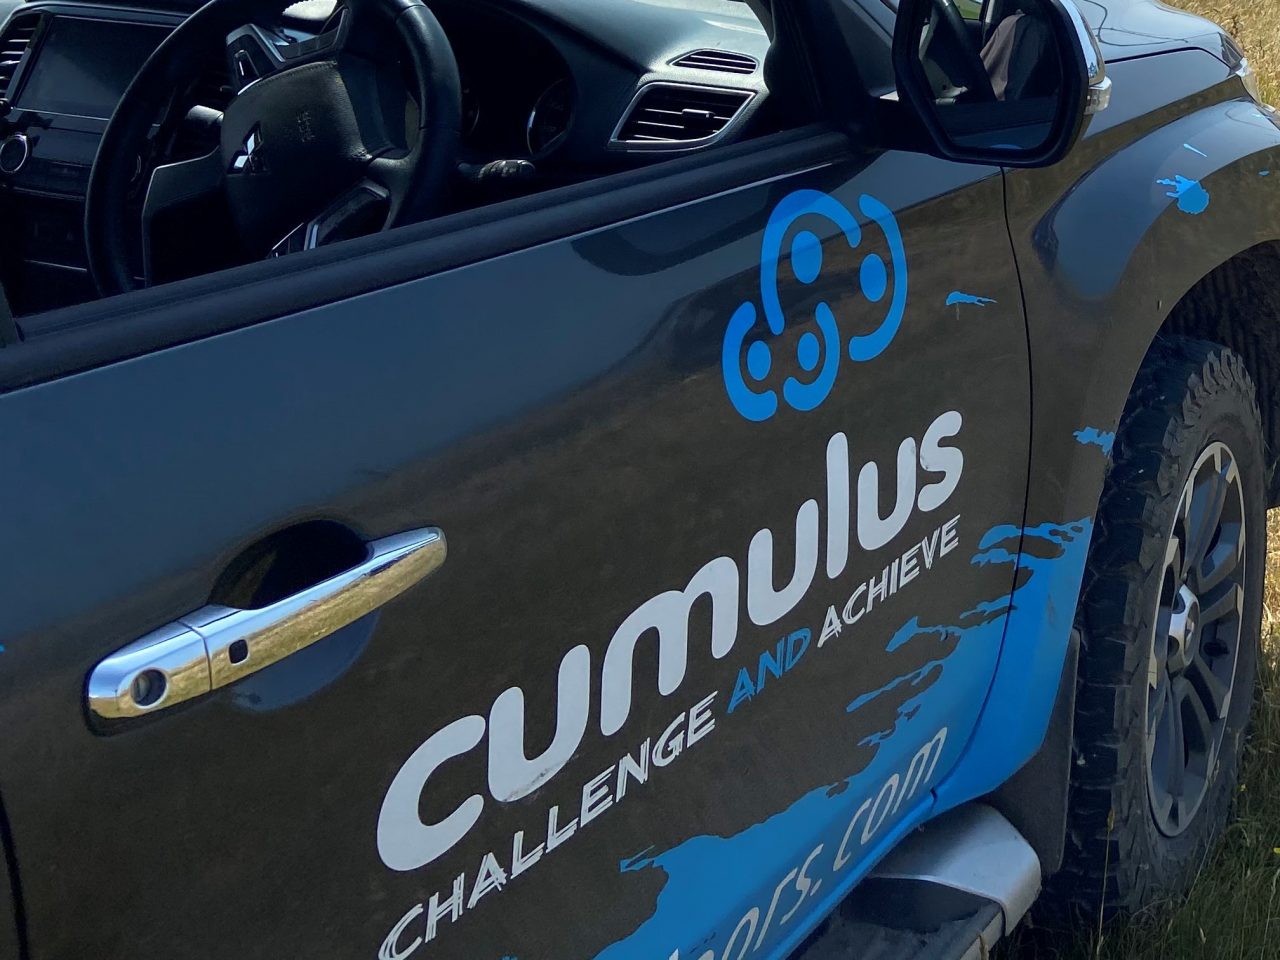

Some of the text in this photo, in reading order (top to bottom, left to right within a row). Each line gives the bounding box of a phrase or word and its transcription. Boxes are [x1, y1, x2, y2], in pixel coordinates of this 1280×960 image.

[377, 410, 964, 872] cumulus
[378, 515, 960, 960] CHALLENGE AND ACHIEVE
[668, 727, 948, 960] ors.com
